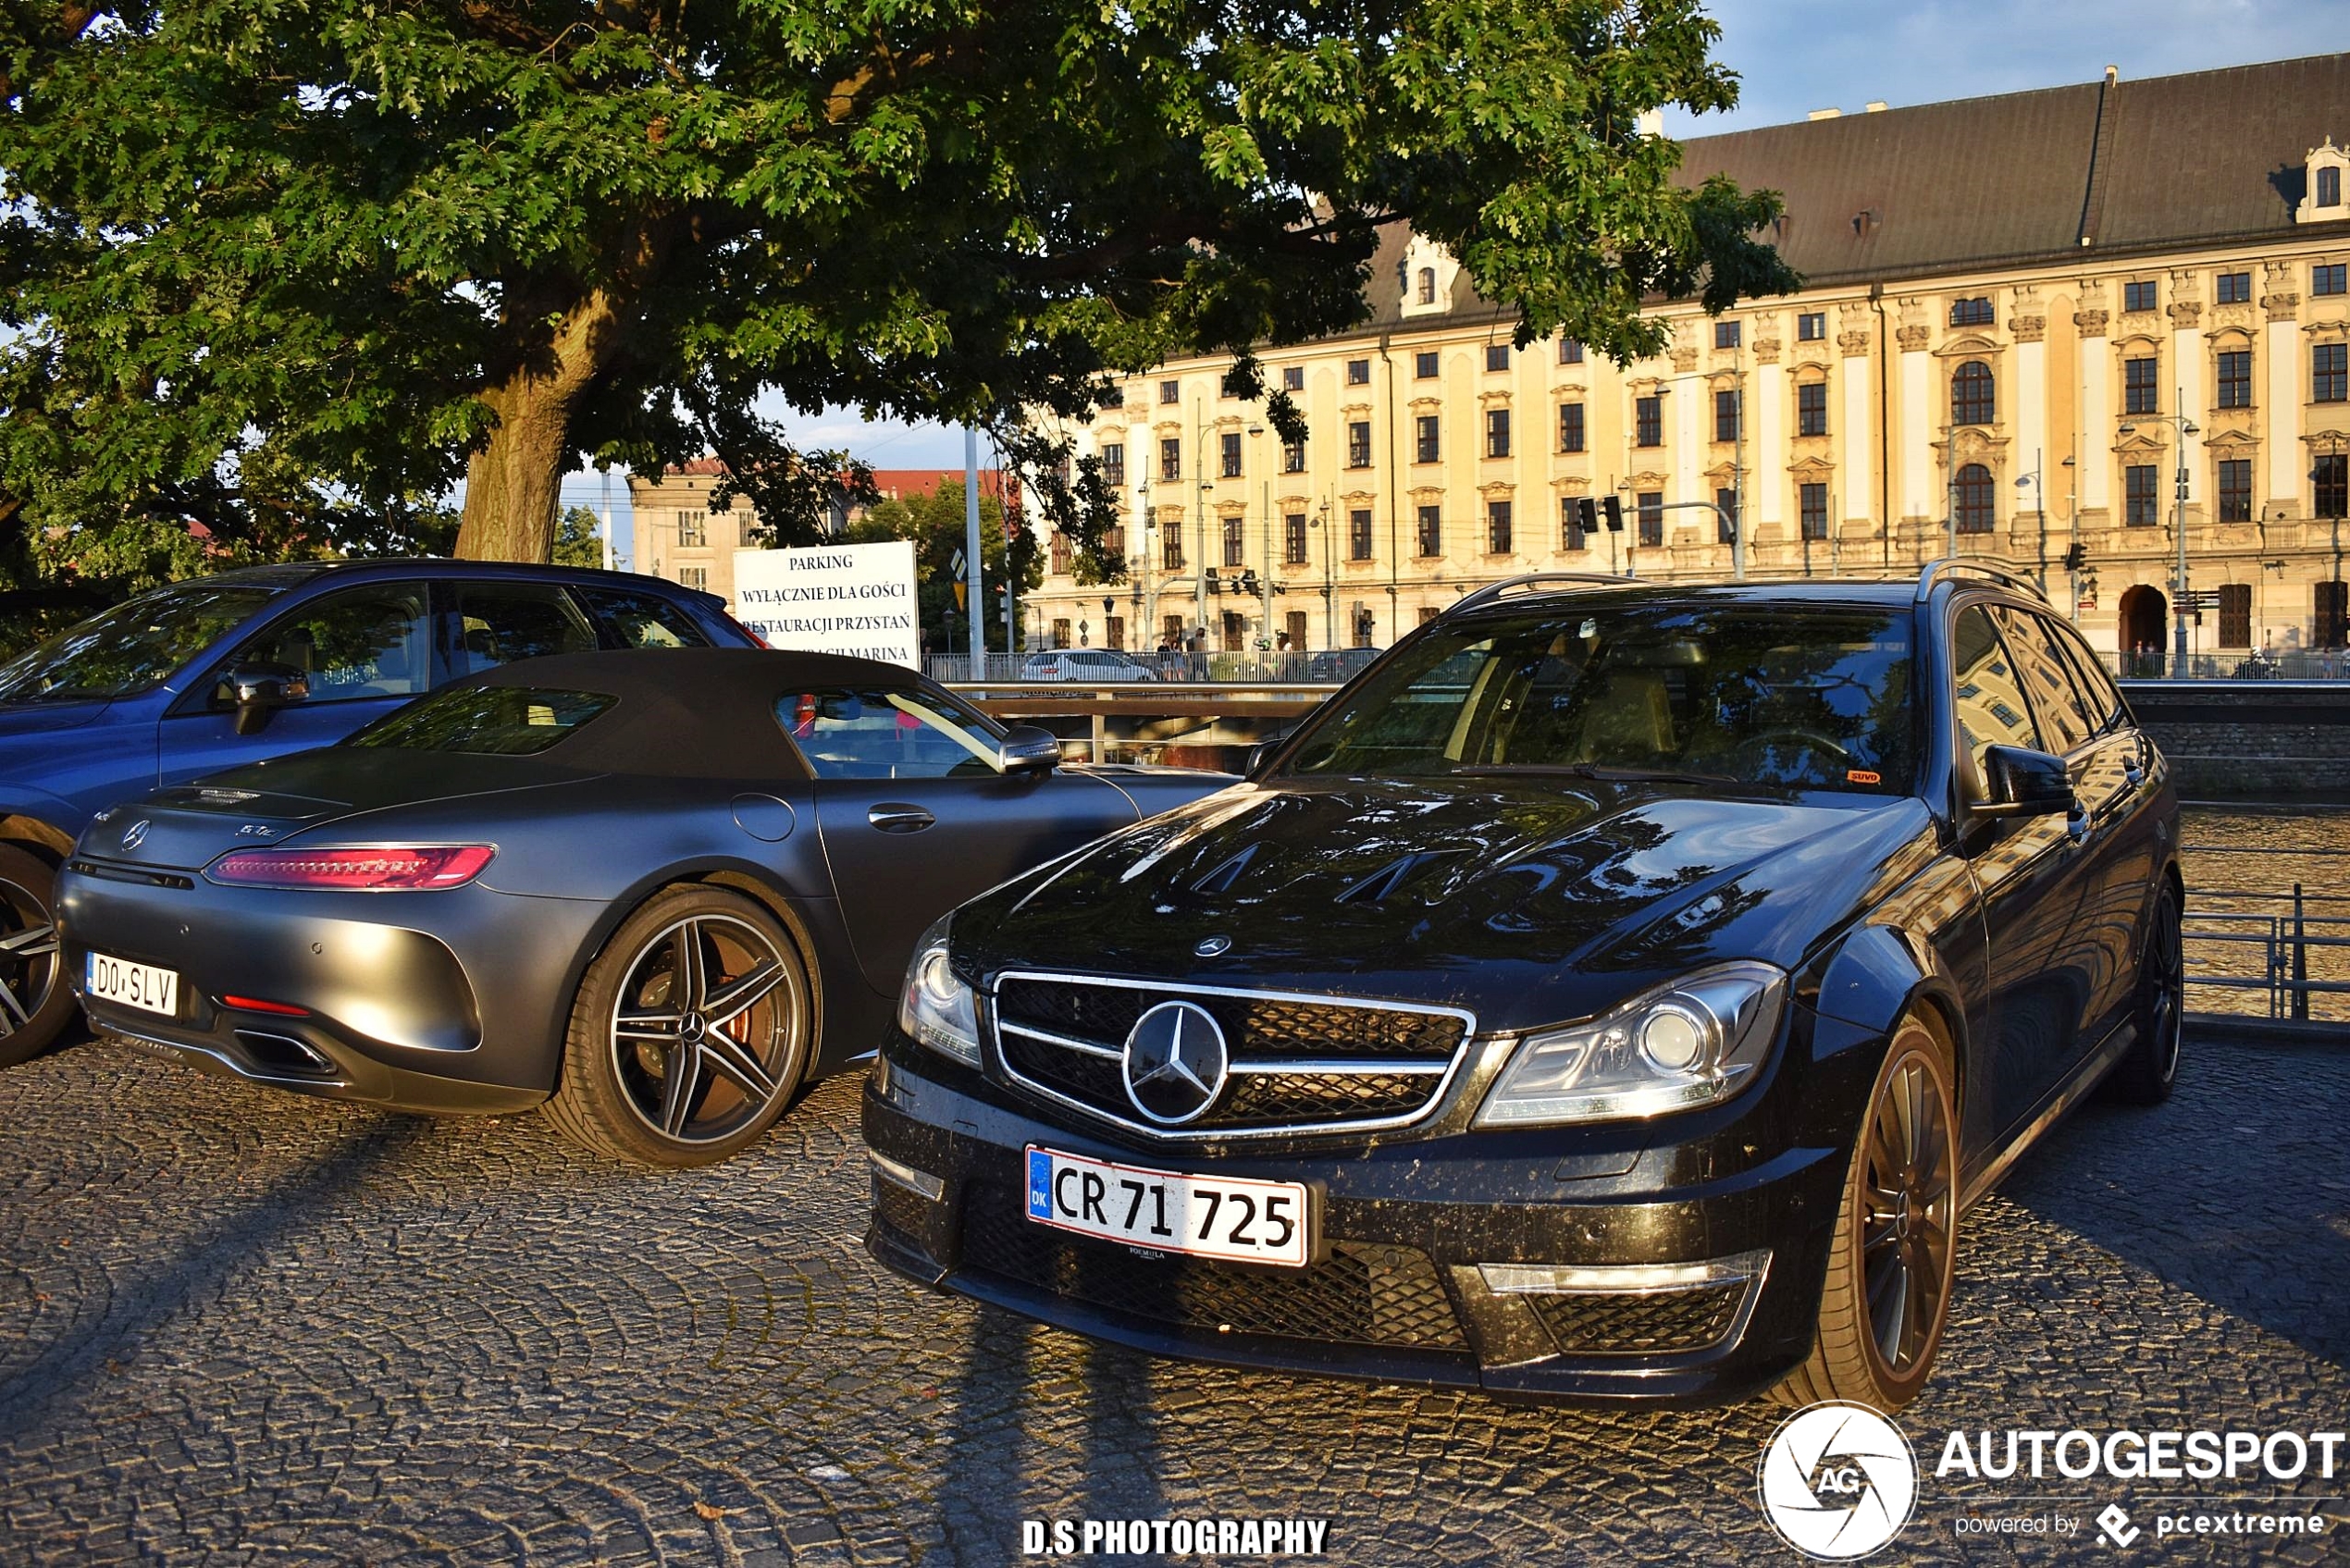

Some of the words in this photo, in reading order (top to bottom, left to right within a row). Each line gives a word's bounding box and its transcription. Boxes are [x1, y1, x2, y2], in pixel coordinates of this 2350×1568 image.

[789, 554, 853, 571] PARKING
[742, 586, 825, 606] WYŁĄCZNIE
[828, 586, 857, 599] DLA
[860, 581, 906, 599] GOŚCI
[835, 612, 910, 631] PRZYSTAŃ
[849, 647, 909, 661] MARINA
[1851, 772, 1877, 781] SUVO
[130, 968, 170, 1009] SLV
[1032, 1191, 1046, 1207] DK
[1055, 1167, 1107, 1225] CR
[1120, 1179, 1172, 1237] 71
[1194, 1189, 1294, 1247] 725
